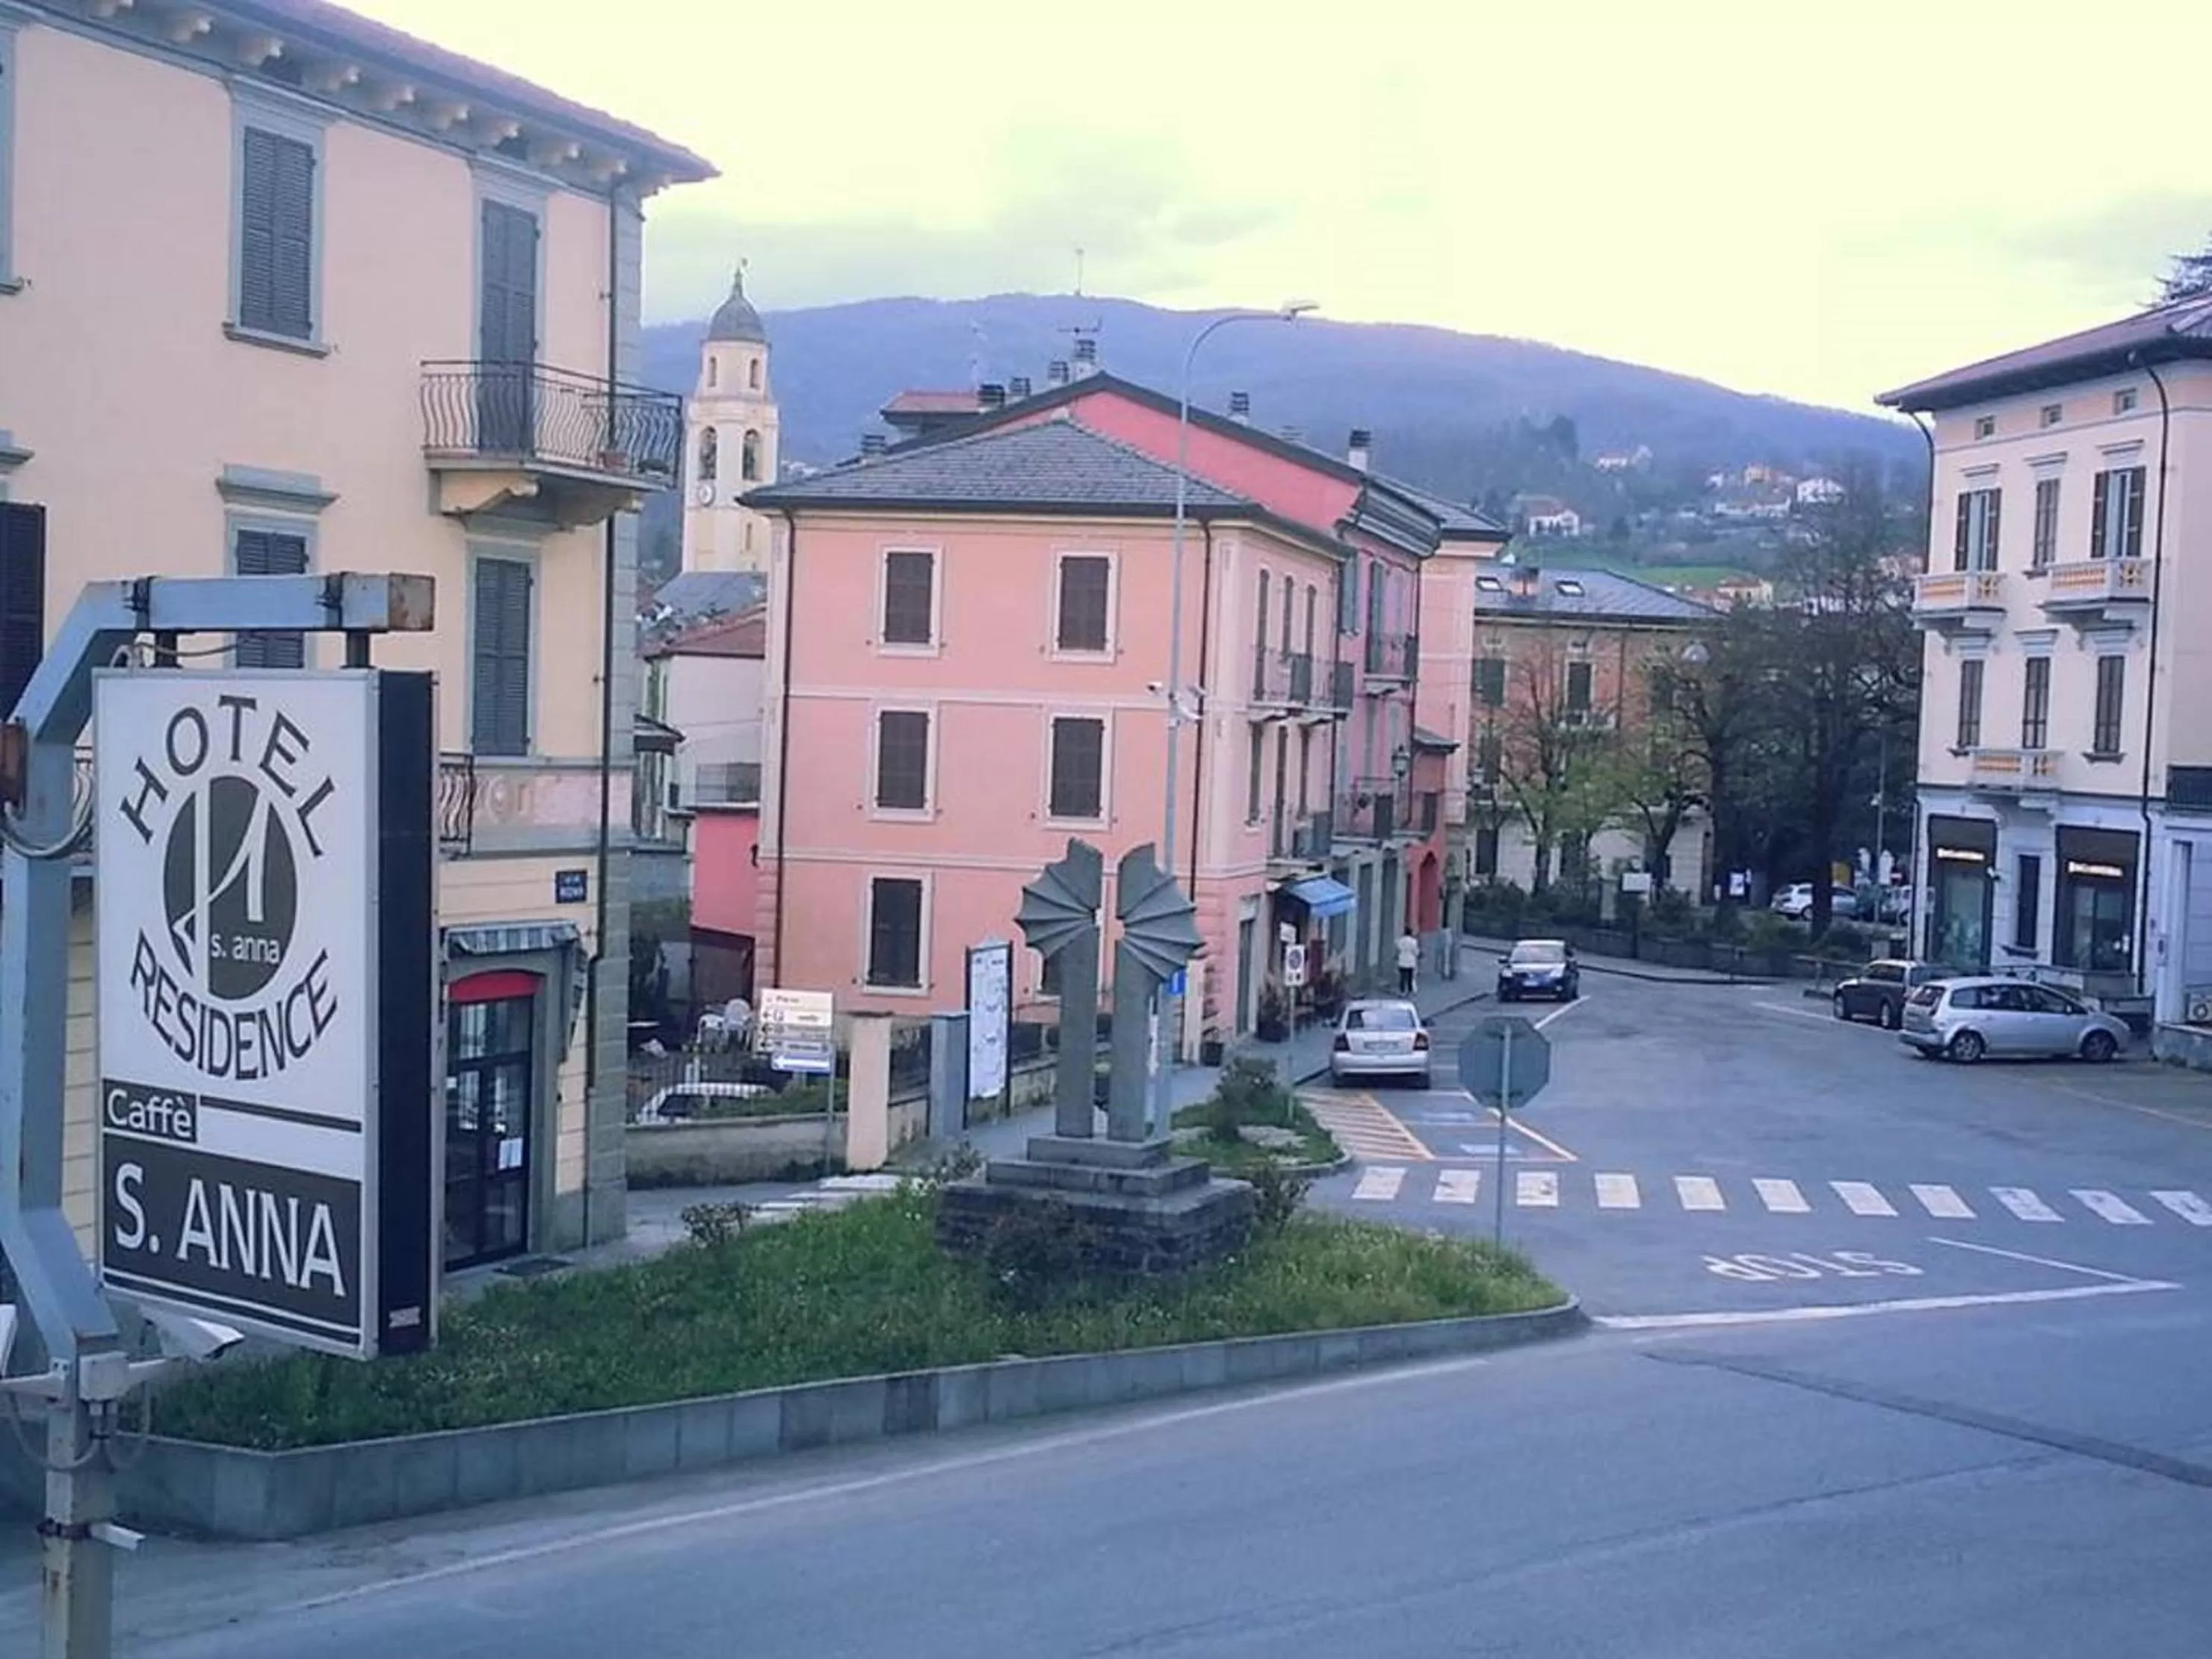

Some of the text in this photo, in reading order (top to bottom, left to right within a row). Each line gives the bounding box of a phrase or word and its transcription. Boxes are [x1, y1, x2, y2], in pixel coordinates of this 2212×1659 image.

[119, 694, 336, 859] HOTEL
[210, 931, 280, 964] s. anna
[130, 927, 339, 1081] RESIDENCE
[107, 1088, 193, 1138] Caffè
[114, 1162, 347, 1297] S. ANNA
[1699, 1251, 1925, 1282] STOP
